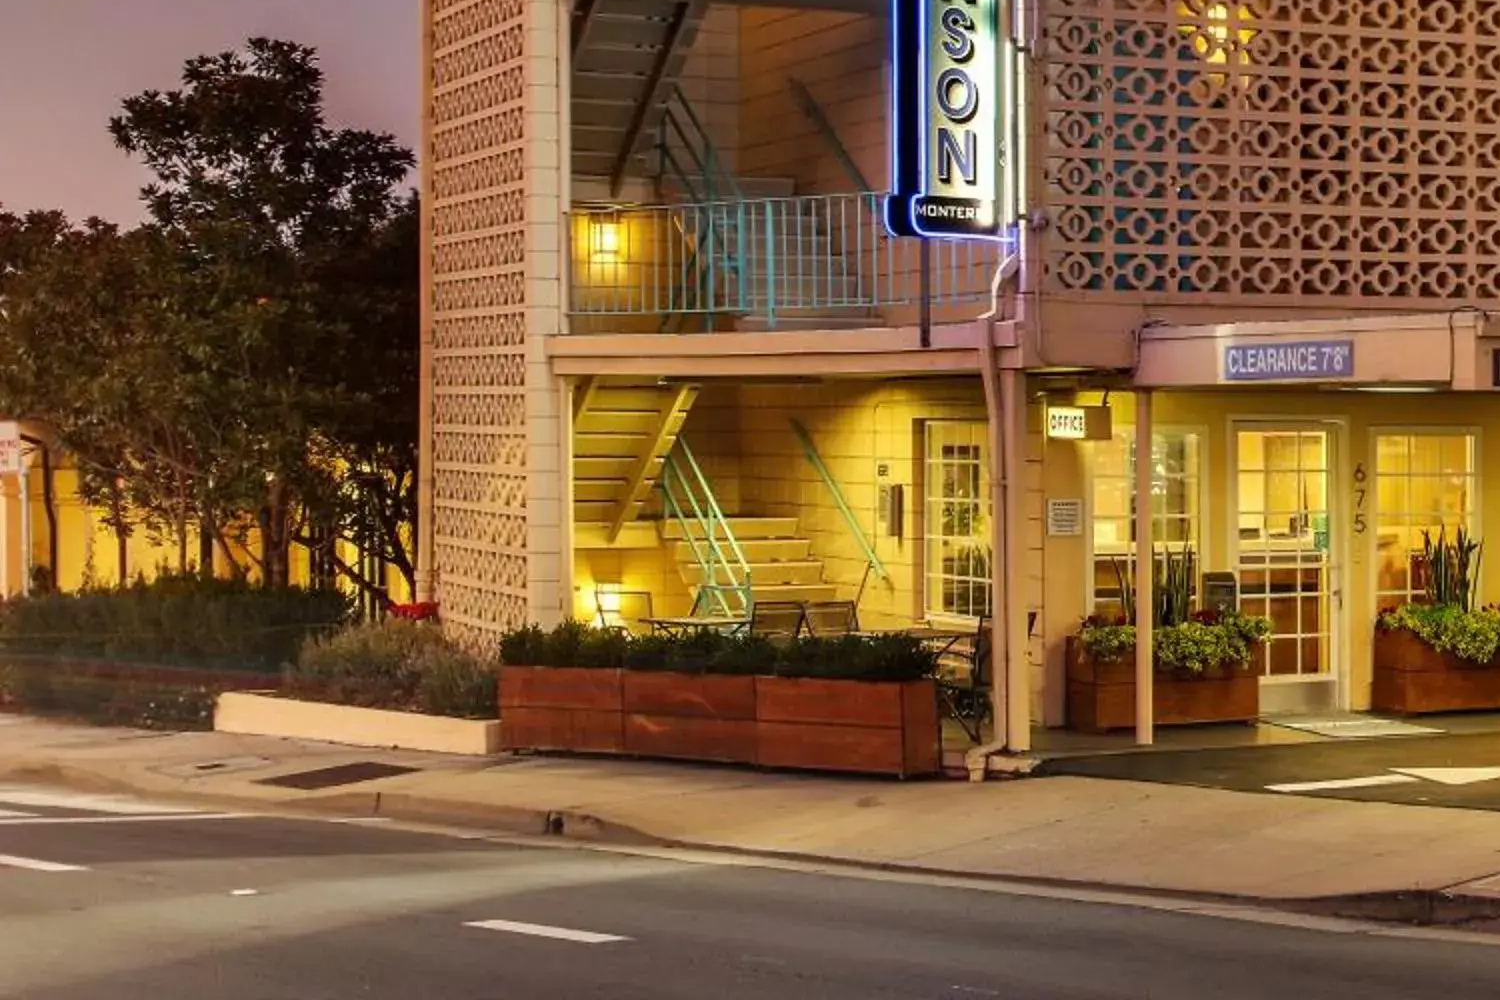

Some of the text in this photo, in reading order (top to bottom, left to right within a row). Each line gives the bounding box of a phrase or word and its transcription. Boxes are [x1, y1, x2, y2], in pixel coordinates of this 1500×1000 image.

[1228, 347, 1317, 373] CLEARANCE
[1050, 414, 1083, 431] OFFICE
[1353, 462, 1367, 534] 675
